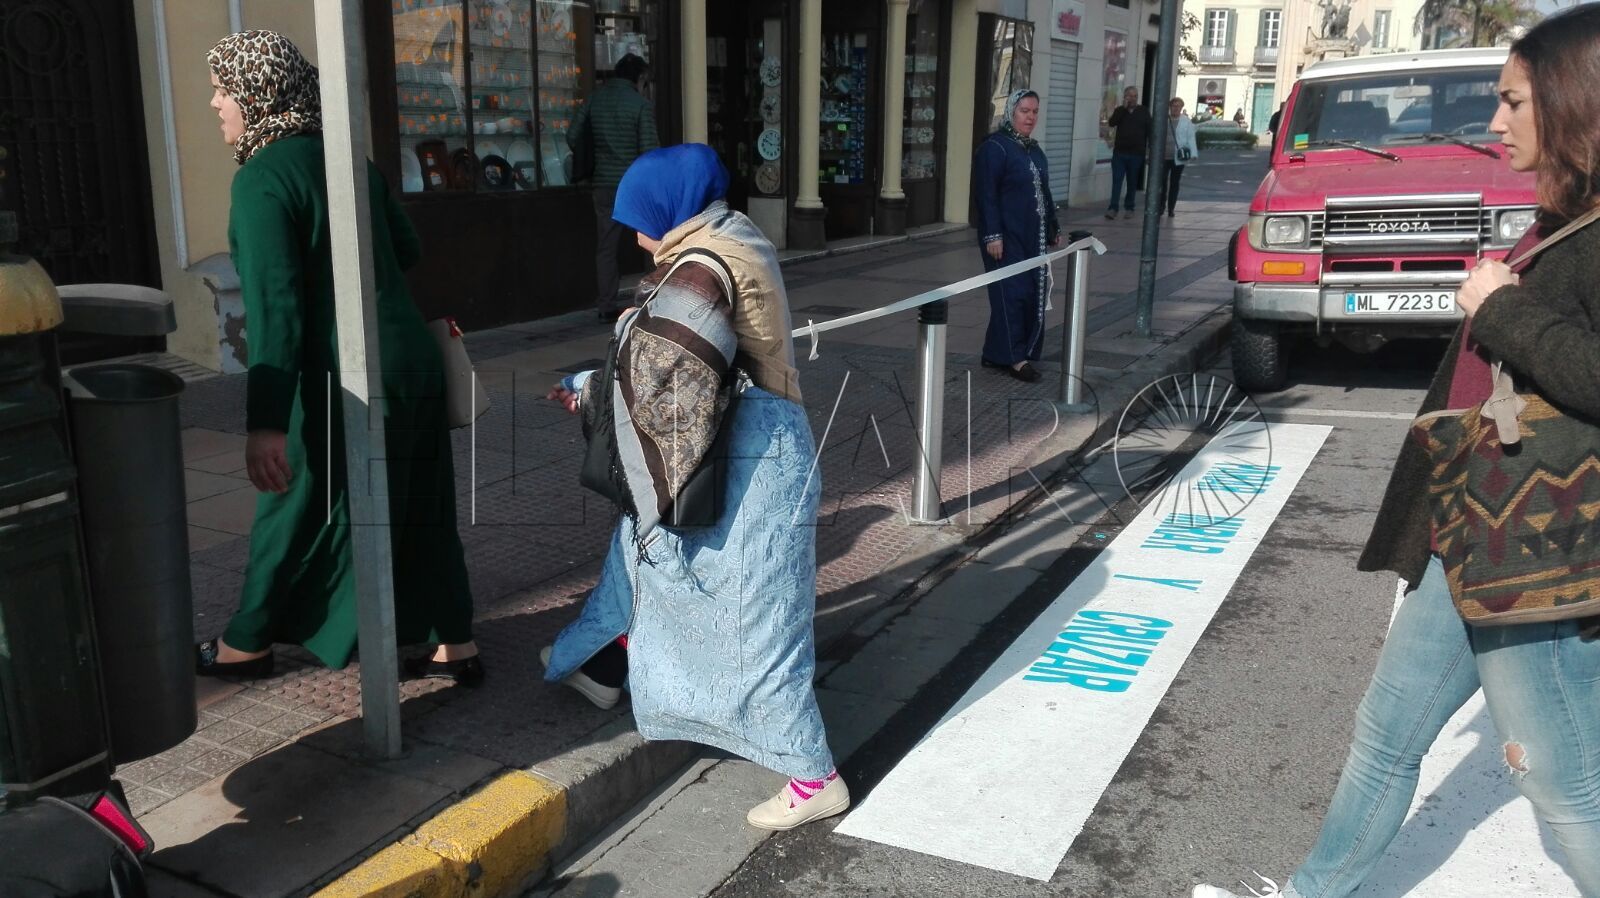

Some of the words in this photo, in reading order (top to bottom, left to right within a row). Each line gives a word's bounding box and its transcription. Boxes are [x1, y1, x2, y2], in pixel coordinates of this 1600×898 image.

[1368, 221, 1431, 233] TOYOTA
[1357, 295, 1379, 311] ML
[1387, 294, 1433, 311] 7223
[1438, 294, 1449, 310] C
[1140, 512, 1246, 555] MIRAR
[1113, 573, 1205, 592] Y
[1022, 609, 1175, 693] CRUZAR
